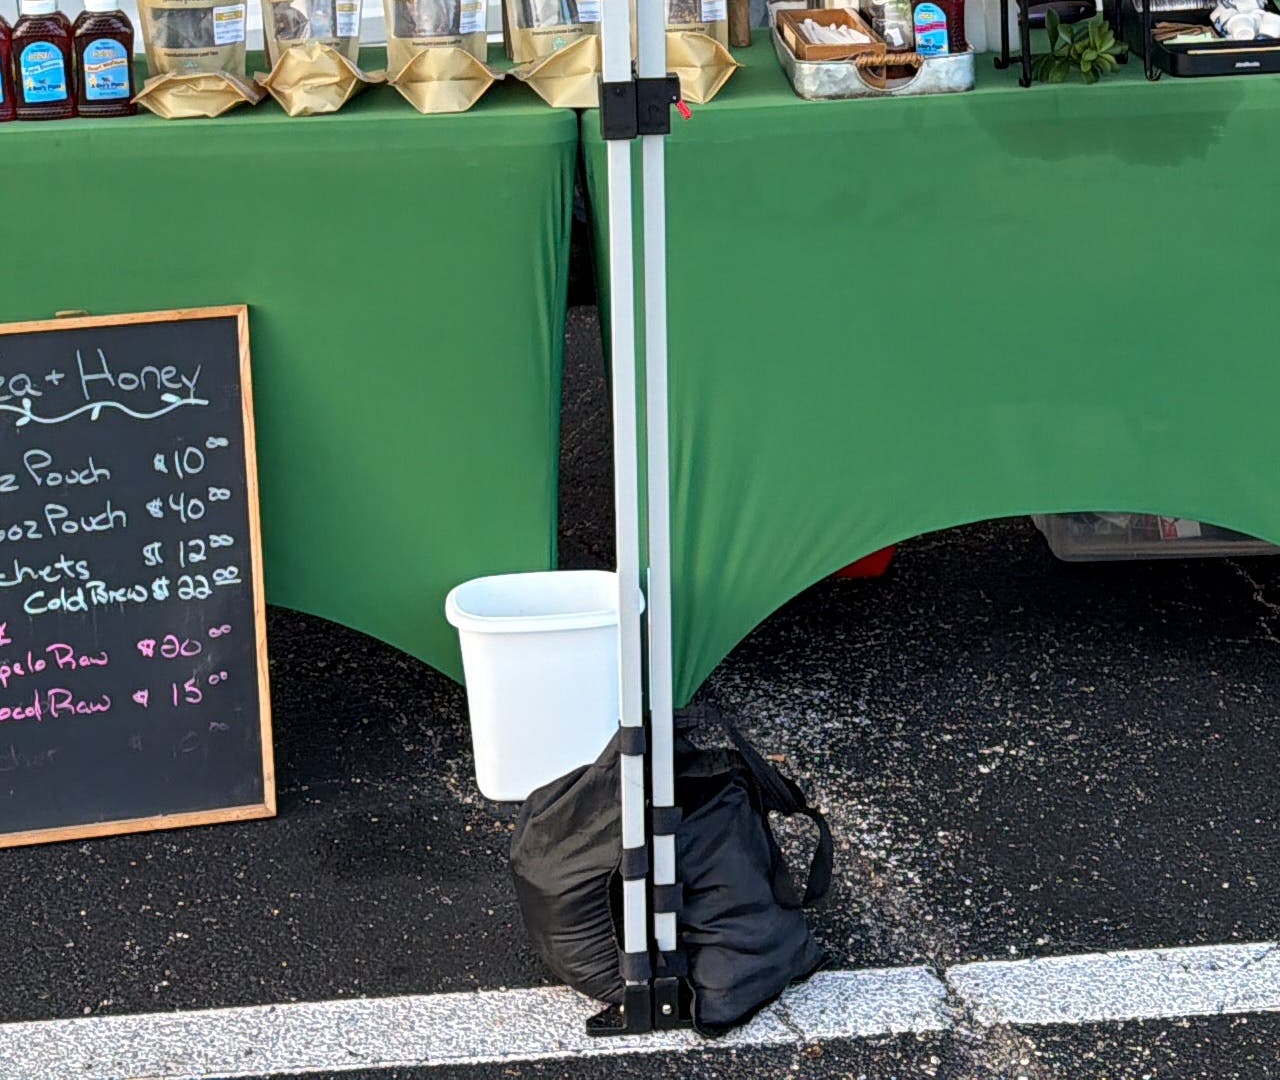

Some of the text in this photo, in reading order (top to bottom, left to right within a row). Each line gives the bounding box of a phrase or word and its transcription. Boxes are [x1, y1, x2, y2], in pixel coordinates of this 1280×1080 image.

[45, 370, 64, 385] +
[76, 349, 202, 400] Honey
[24, 449, 111, 488] Pouch
[45, 500, 127, 537] Pouch
[24, 585, 88, 615] Cold
[90, 581, 148, 606] Brew
[46, 644, 108, 668] Raw
[48, 688, 111, 714] Raw
